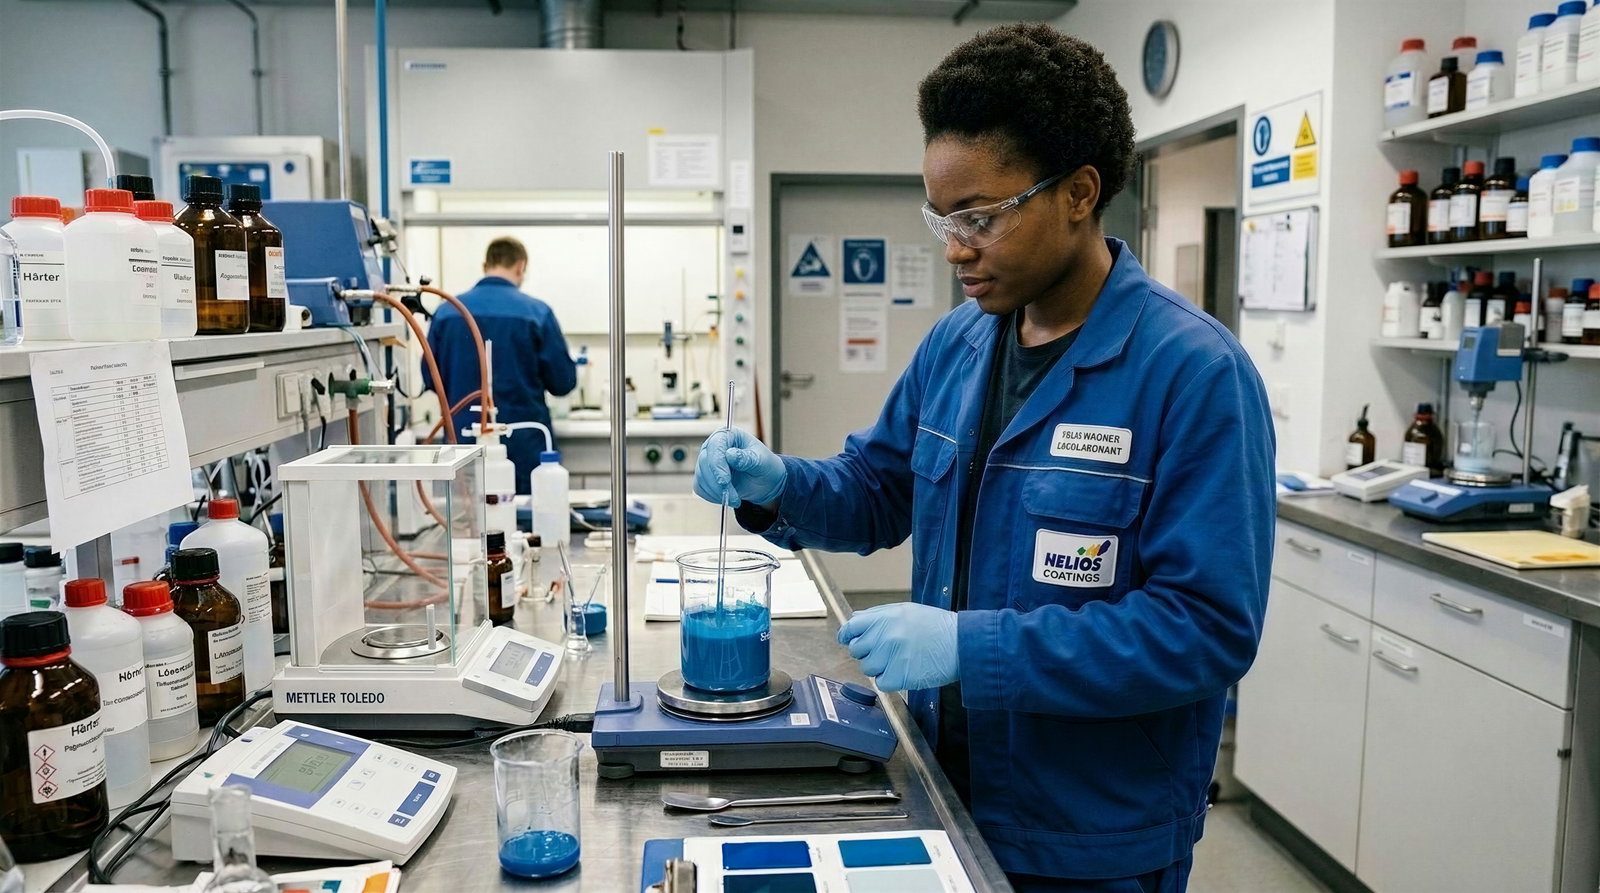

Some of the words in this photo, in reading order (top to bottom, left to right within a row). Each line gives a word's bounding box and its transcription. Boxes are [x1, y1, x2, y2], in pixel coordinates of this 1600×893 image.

[1044, 553, 1103, 572] NELIOS
[1043, 569, 1100, 583] COATINGS
[286, 692, 336, 703] METTLER
[340, 692, 385, 703] TOLEDO
